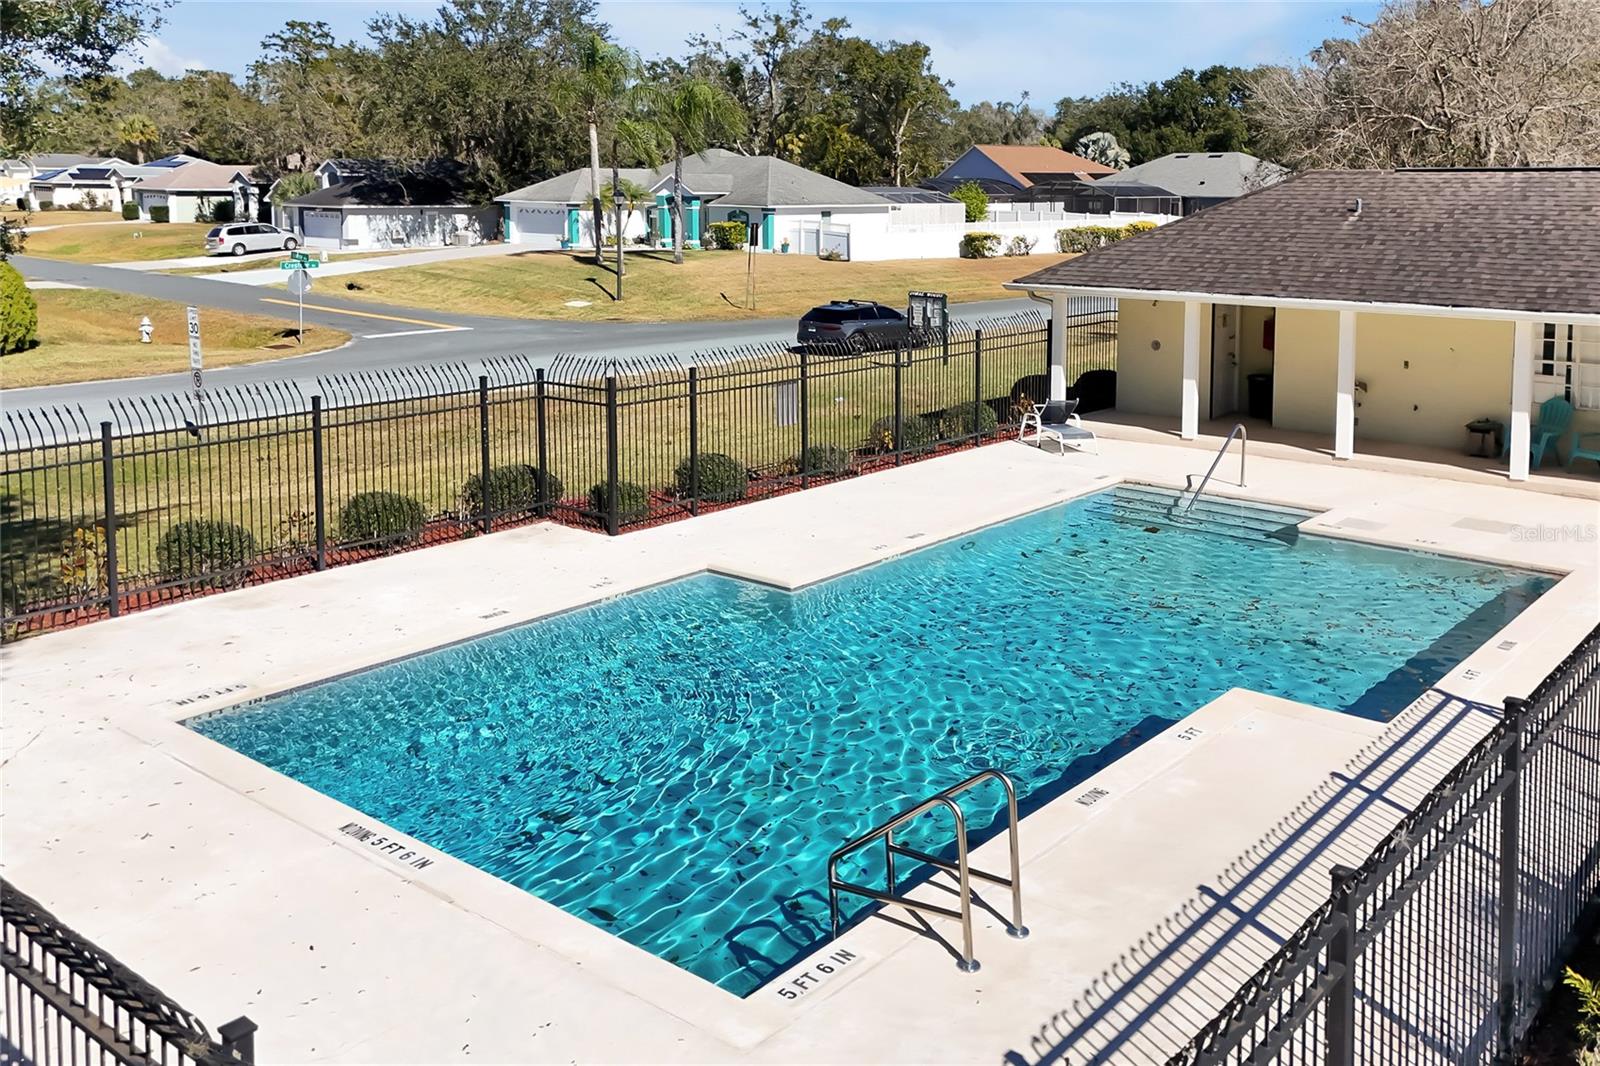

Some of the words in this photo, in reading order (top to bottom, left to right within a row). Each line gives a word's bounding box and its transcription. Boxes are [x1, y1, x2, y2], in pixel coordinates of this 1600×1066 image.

[189, 322, 199, 334] 30
[1184, 727, 1203, 737] FT
[371, 837, 388, 846] 5
[380, 842, 406, 855] FT
[398, 851, 417, 860] 6
[409, 856, 434, 870] IN
[777, 987, 798, 1000] 5
[791, 971, 819, 990] FT
[815, 963, 835, 974] 6
[829, 949, 857, 966] IN
